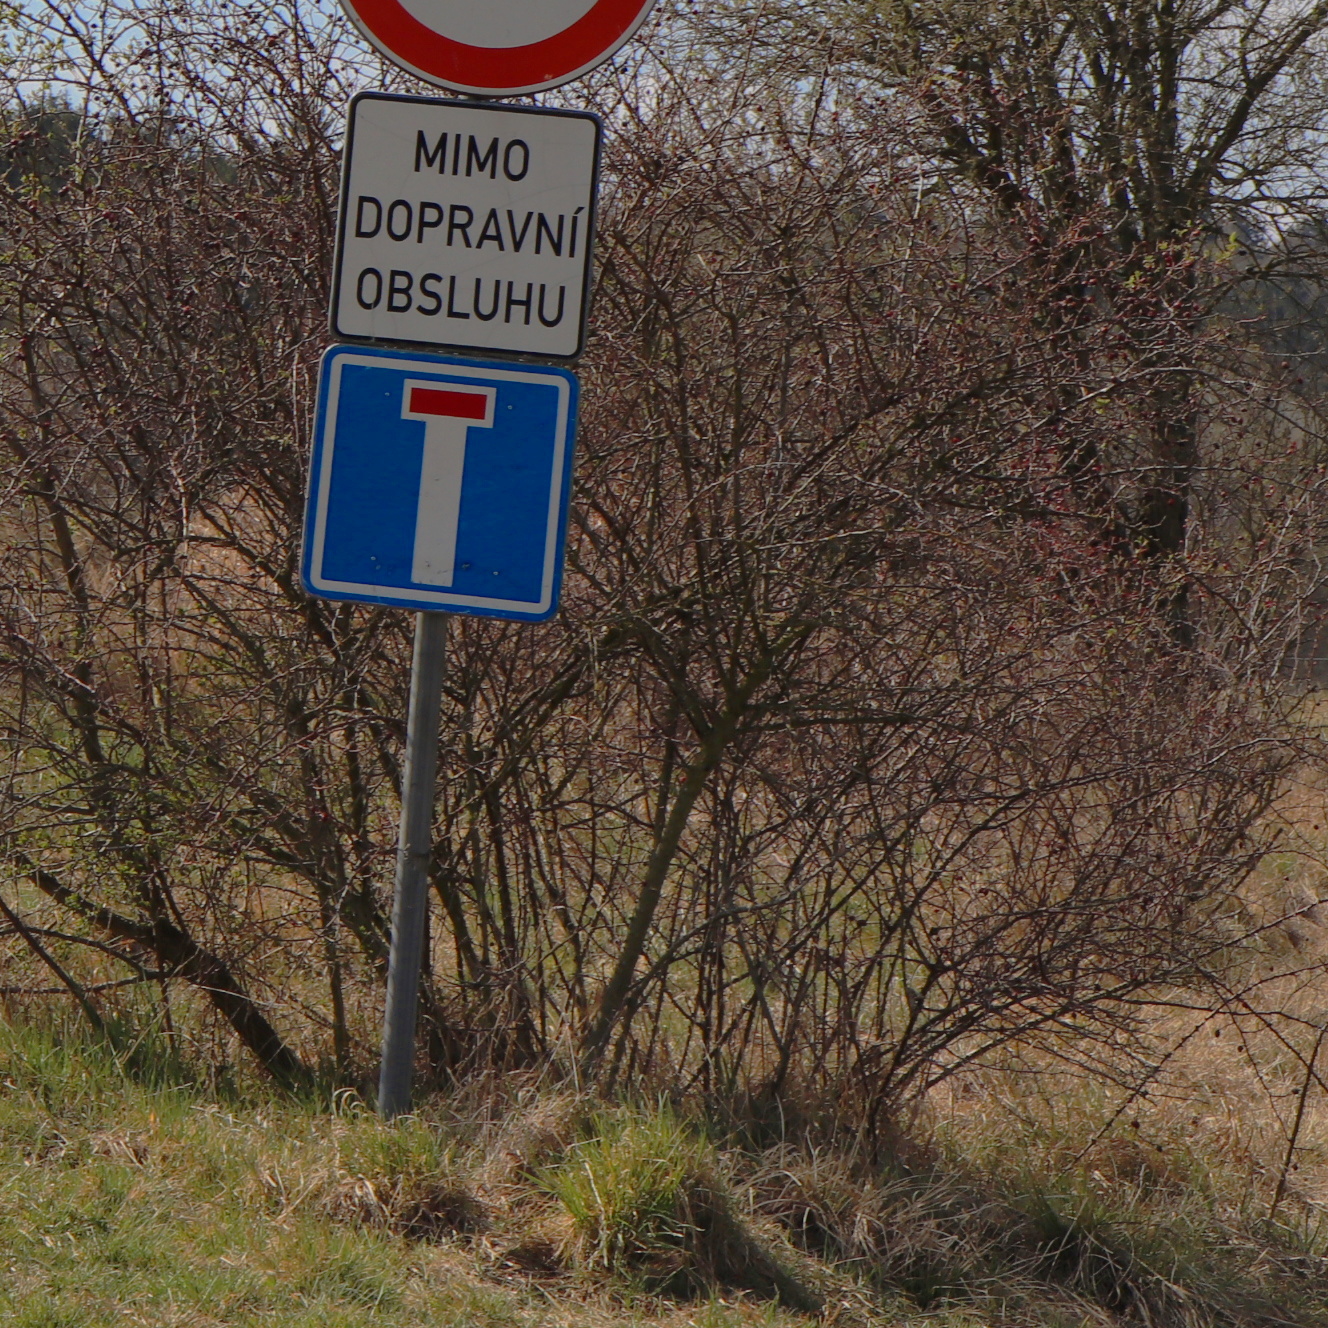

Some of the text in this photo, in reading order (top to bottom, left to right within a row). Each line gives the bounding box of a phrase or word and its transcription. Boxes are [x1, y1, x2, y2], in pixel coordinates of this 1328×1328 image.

[414, 130, 530, 182] MIMO
[354, 195, 585, 258] DOPRAVNÍ
[356, 267, 566, 328] OBSLUHU
